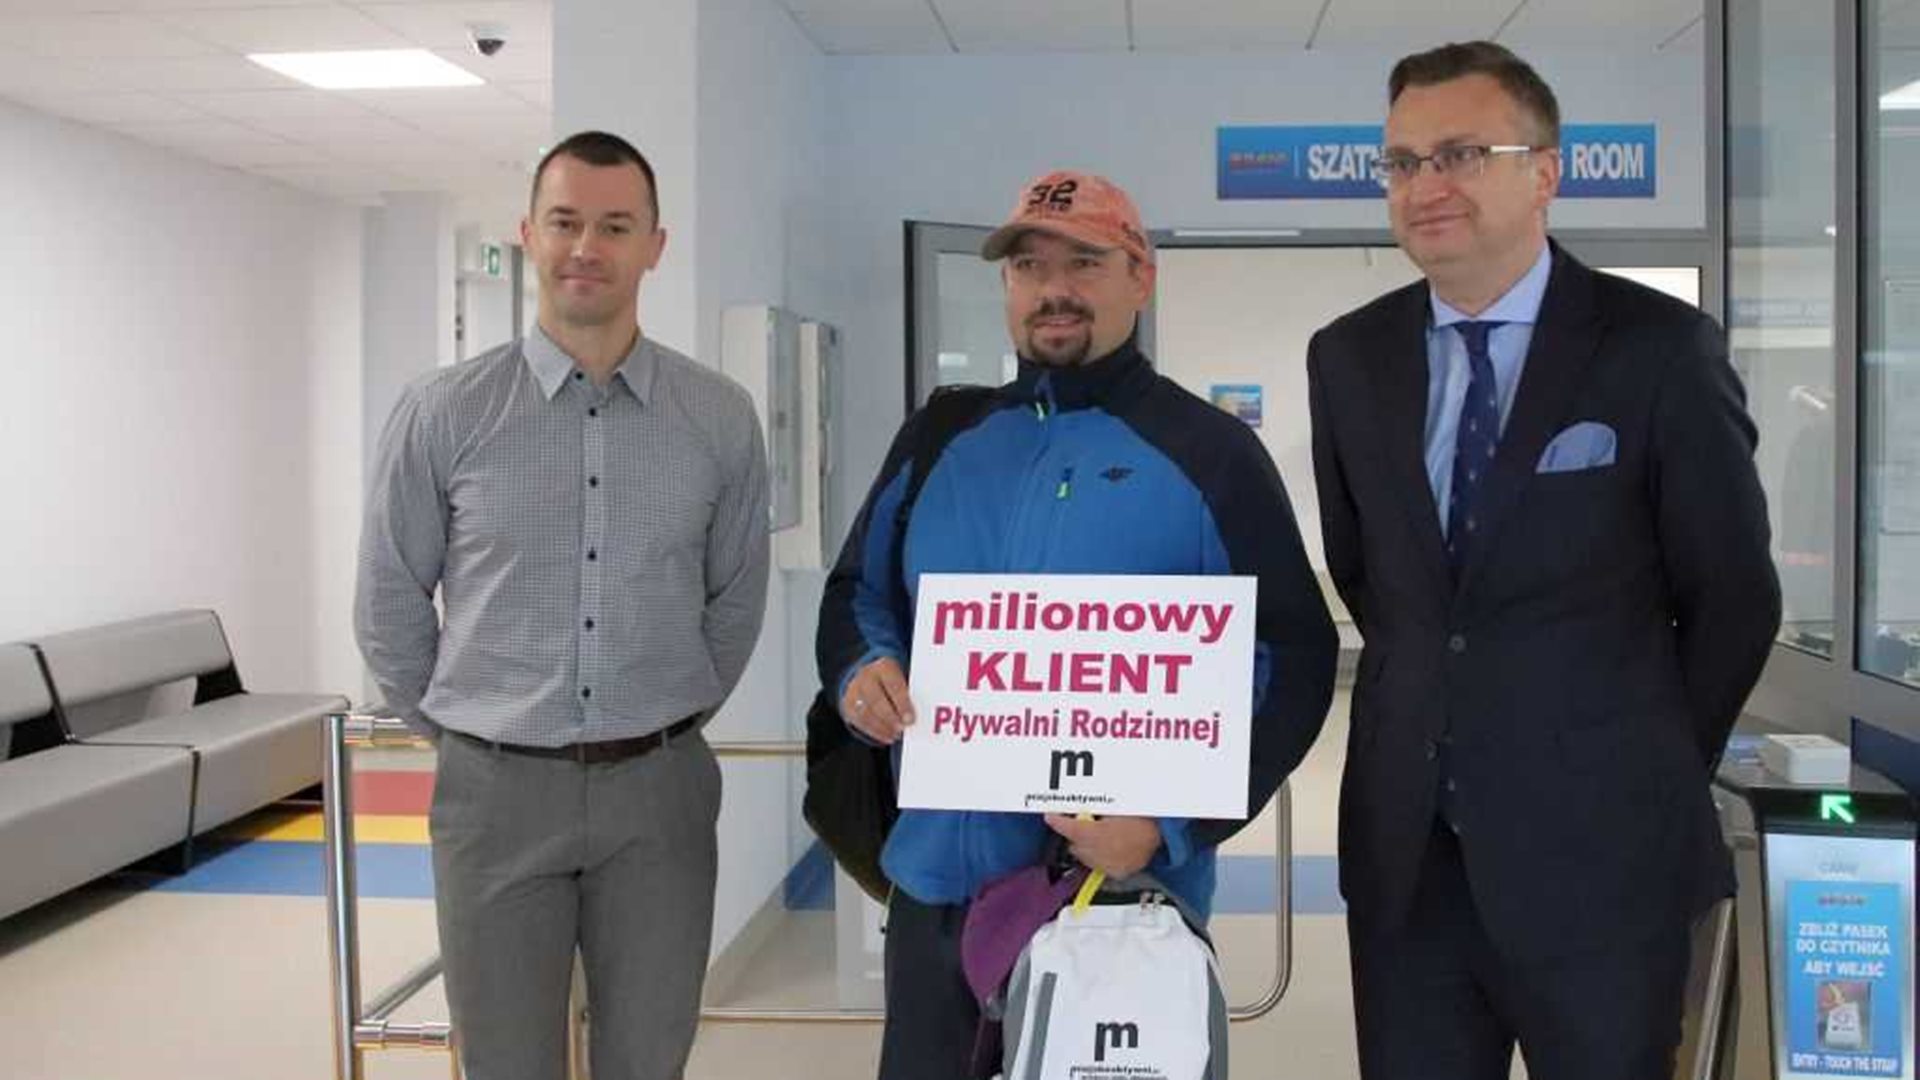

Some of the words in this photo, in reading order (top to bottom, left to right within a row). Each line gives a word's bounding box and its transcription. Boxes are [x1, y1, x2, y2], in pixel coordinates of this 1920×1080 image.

[1572, 143, 1644, 179] ROOM
[1028, 180, 1077, 206] 32
[932, 592, 1234, 645] milionowy
[966, 651, 1193, 694] KLIENT
[933, 706, 1060, 742] Pływalni
[1070, 708, 1221, 748] Rodzinnej
[1796, 938, 1817, 954] DO
[1820, 940, 1890, 956] CZYTNIKA
[1843, 924, 1888, 939] PASEK
[1803, 959, 1833, 975] ABY
